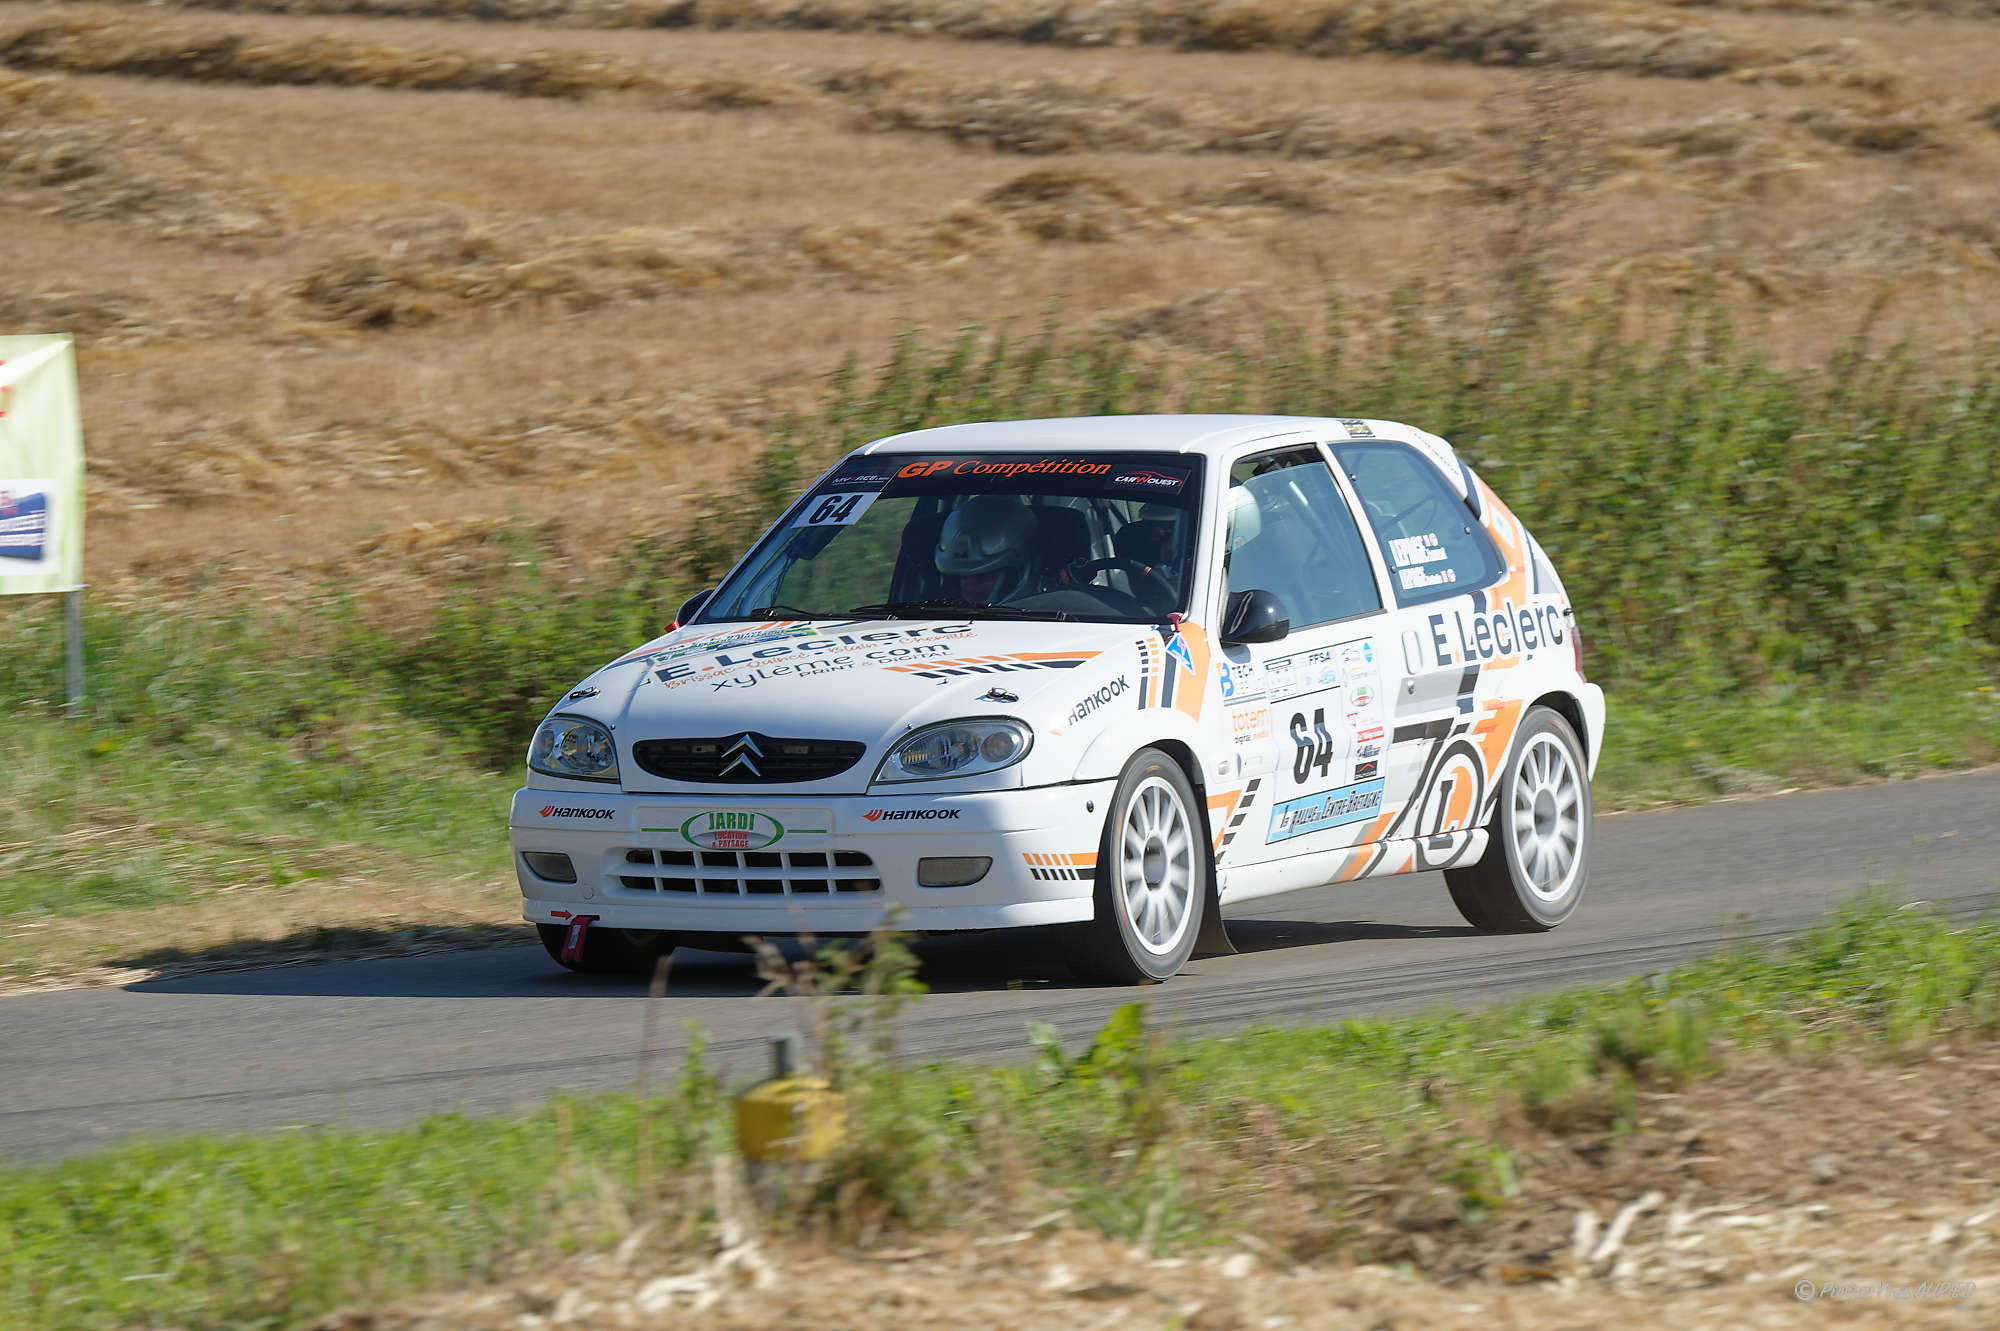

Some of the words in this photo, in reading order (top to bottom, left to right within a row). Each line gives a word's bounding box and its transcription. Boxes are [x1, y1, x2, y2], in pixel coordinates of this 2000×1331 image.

[897, 460, 953, 478] GP
[953, 458, 1112, 477] Compétition
[808, 494, 864, 524] 64
[799, 663, 855, 678] PRINT
[879, 650, 953, 665] DIGITAL
[1232, 708, 1270, 732] totem
[1290, 708, 1334, 784] 64
[709, 812, 755, 831] JARDI
[714, 832, 748, 841] LOCATION
[718, 840, 749, 848] PAYSAGE
